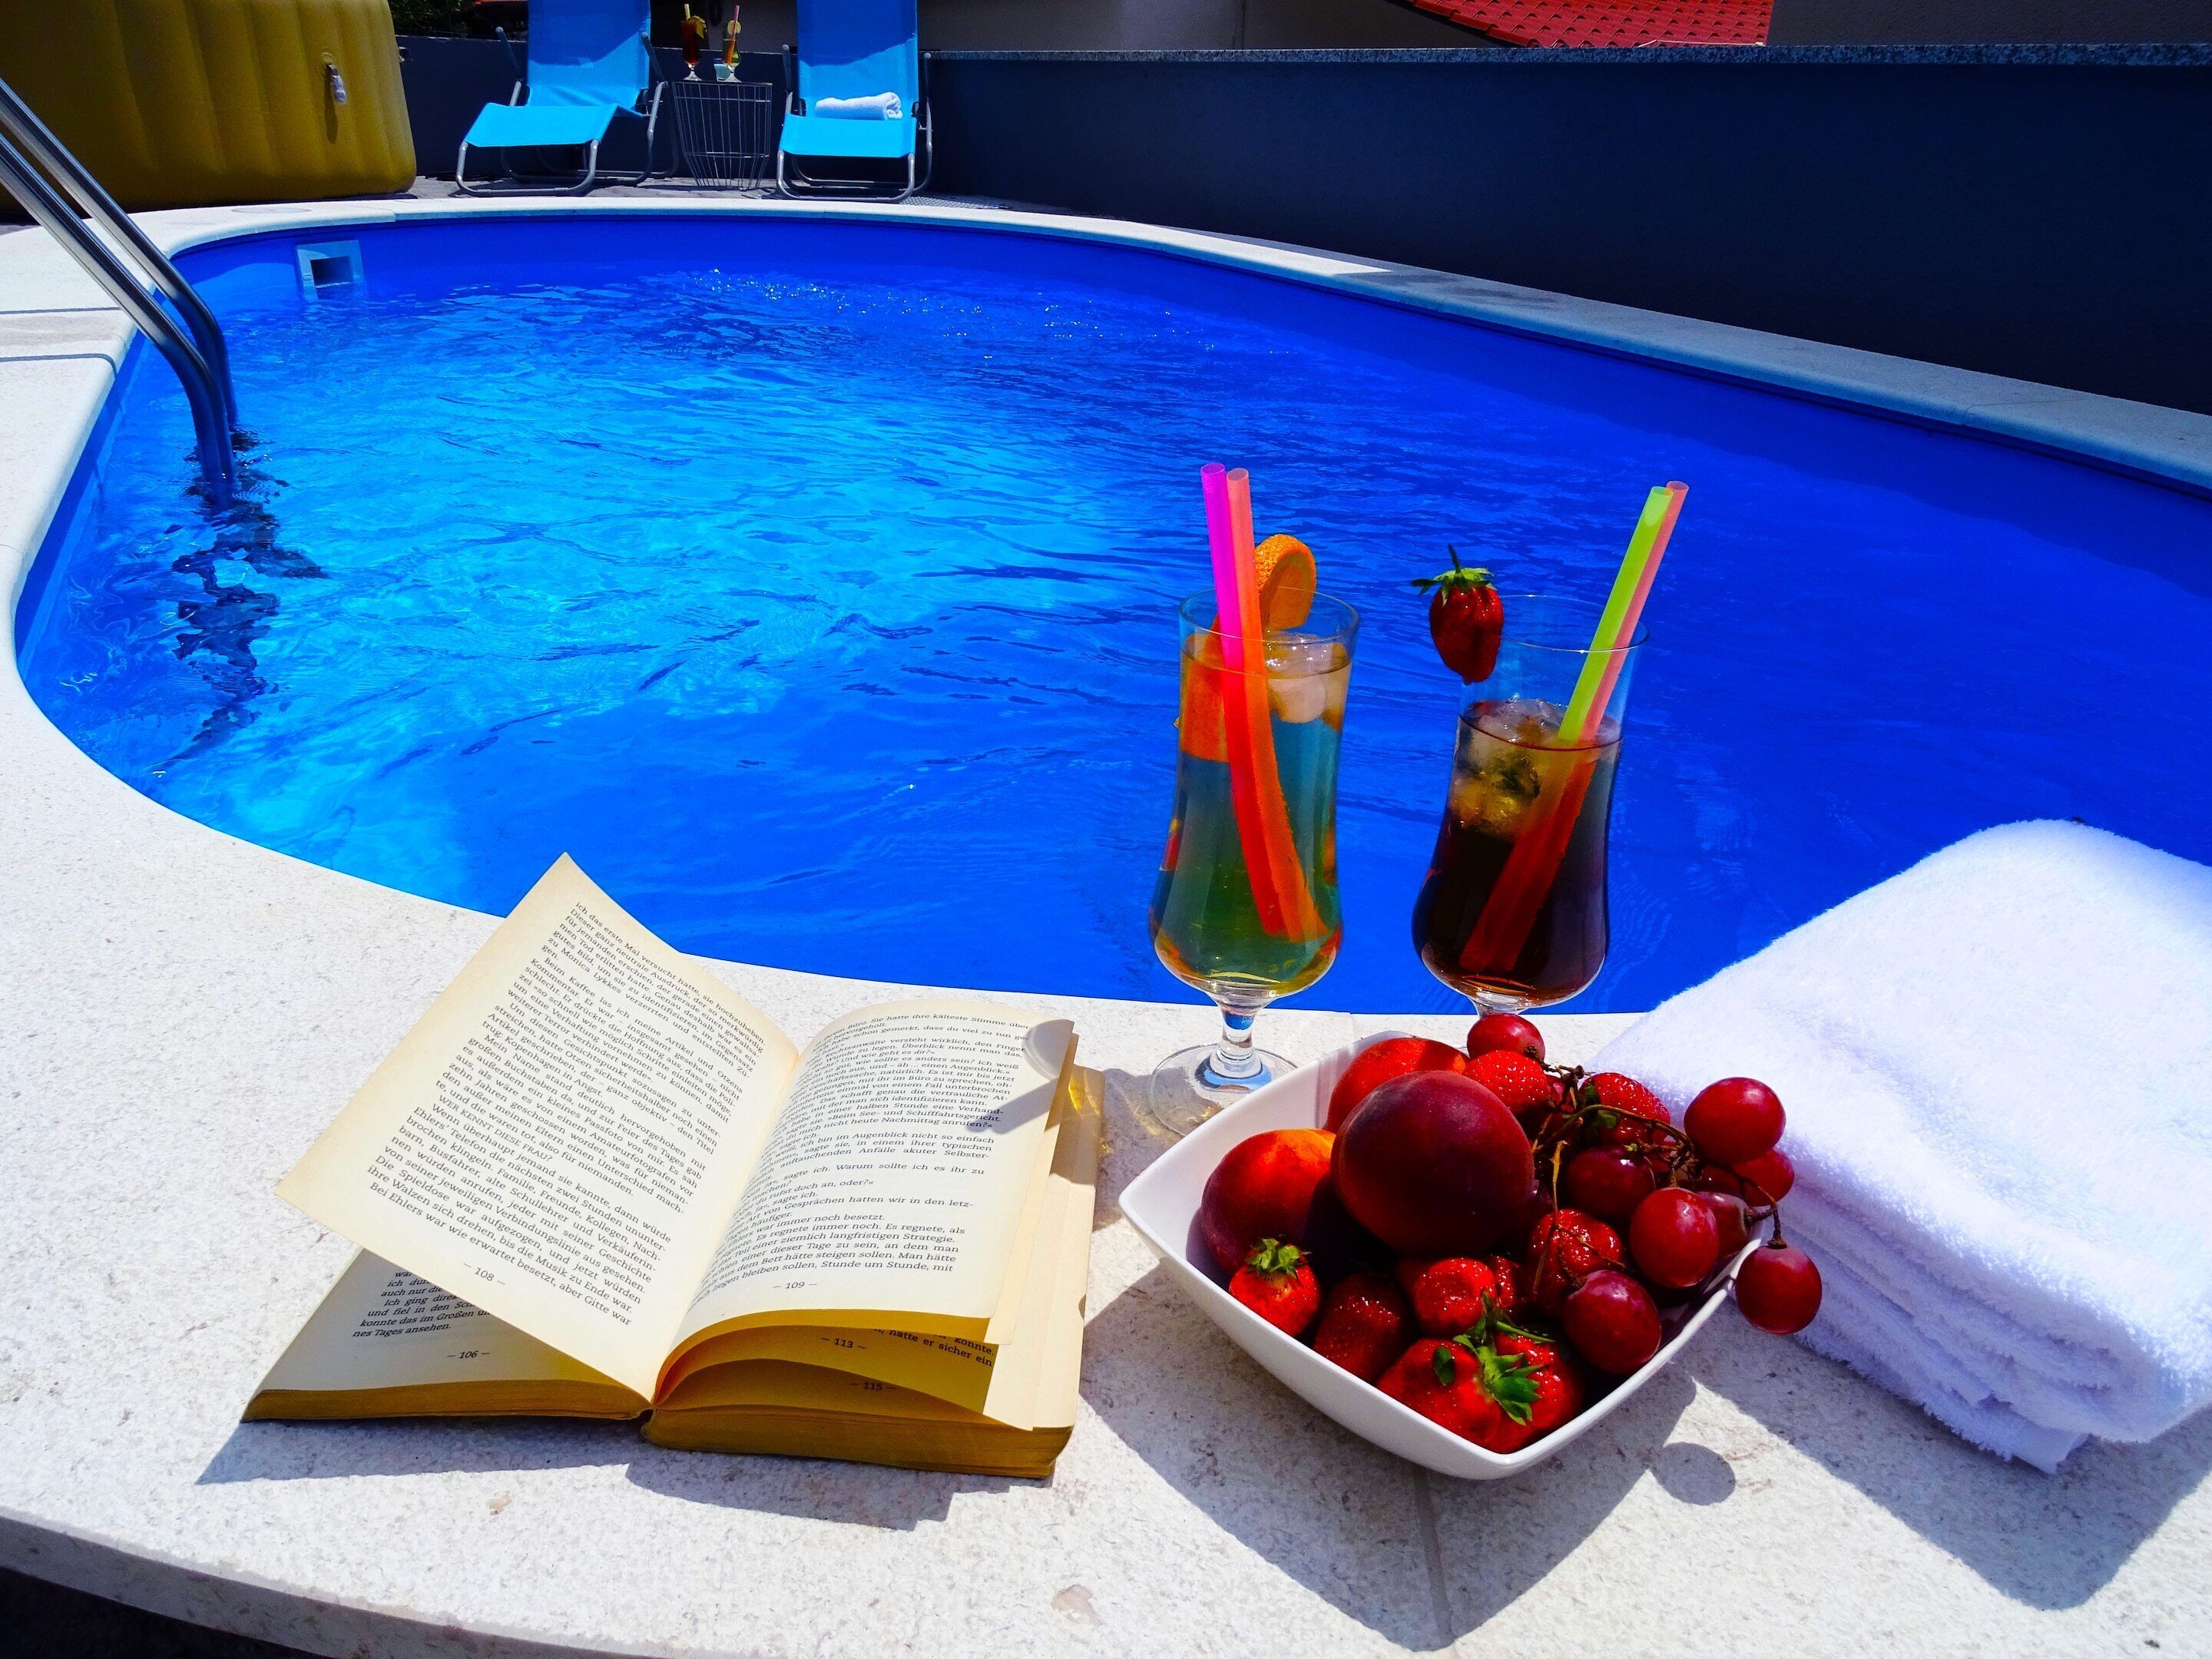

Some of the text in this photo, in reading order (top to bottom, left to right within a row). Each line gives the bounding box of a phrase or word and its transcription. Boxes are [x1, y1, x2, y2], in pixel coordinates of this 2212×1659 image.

[513, 981, 729, 1123] um eine Verhaftung vornehmen zu können, damit
[439, 1094, 553, 1161] WER KENNT DIESE FRAU?
[851, 1131, 908, 1139] Augenblick
[955, 1134, 994, 1144] einfach
[406, 1114, 661, 1260] brochen klingeln. Familie, Freunde, Kollegen, Nach-
[412, 1106, 665, 1250] Ehlers' Telefon die nächsten zwei Stunden ununter-
[398, 1124, 655, 1270] barn, Busfahrer, alte Schullehrer und Verkäuferin-
[768, 1187, 792, 1200] rufst
[793, 1182, 818, 1192] doch
[390, 1136, 651, 1283] nen würden anrufen, jeder mit seiner Geschichte
[763, 1206, 780, 1216] von
[783, 1197, 844, 1209] Gesprächen
[948, 1199, 973, 1207] letz-
[384, 1145, 644, 1293] von seiner jeweiligen Verbindungslinie aus gesehen.
[756, 1223, 775, 1233] war
[776, 1217, 812, 1227] immer
[813, 1214, 840, 1222] noch
[366, 1164, 632, 1313] ihre Walzen sich drehen, bis die Musik zu Ende war.
[375, 1154, 641, 1304] Die Spieldose war aufgezogen, und jetzt würden
[769, 1226, 809, 1237] regnete
[900, 1224, 945, 1233] regnete,
[949, 1226, 965, 1234] als
[751, 1230, 955, 1250] einer ziemlich langfristigen Strategie.
[770, 1244, 803, 1253] dieser
[806, 1242, 831, 1250] Tage
[853, 1240, 879, 1249] sein,
[902, 1241, 928, 1250] dem
[369, 1181, 631, 1325] Bei Ehlers war wie erwartet besetzt, aber Gitte war
[736, 1250, 956, 1272] dem Bett hätte steigen sollen. Man hätte
[475, 1267, 495, 1283] 108
[741, 1265, 779, 1278] bleiben
[781, 1261, 817, 1270] sollen,
[886, 1260, 929, 1270] Stunde,
[408, 1287, 427, 1296] nur
[784, 1280, 805, 1289] 109
[384, 1298, 400, 1306] Ich
[404, 1296, 429, 1306] ging
[392, 1306, 411, 1315] fiel
[359, 1318, 397, 1327] konnte
[437, 1310, 475, 1321] Großen
[375, 1329, 403, 1337] Tages
[405, 1323, 452, 1333] ansehen.
[834, 1338, 854, 1349] 113
[923, 1338, 935, 1347] er
[939, 1343, 972, 1359] sicher
[975, 1355, 992, 1367] ein
[459, 1350, 479, 1359] 106
